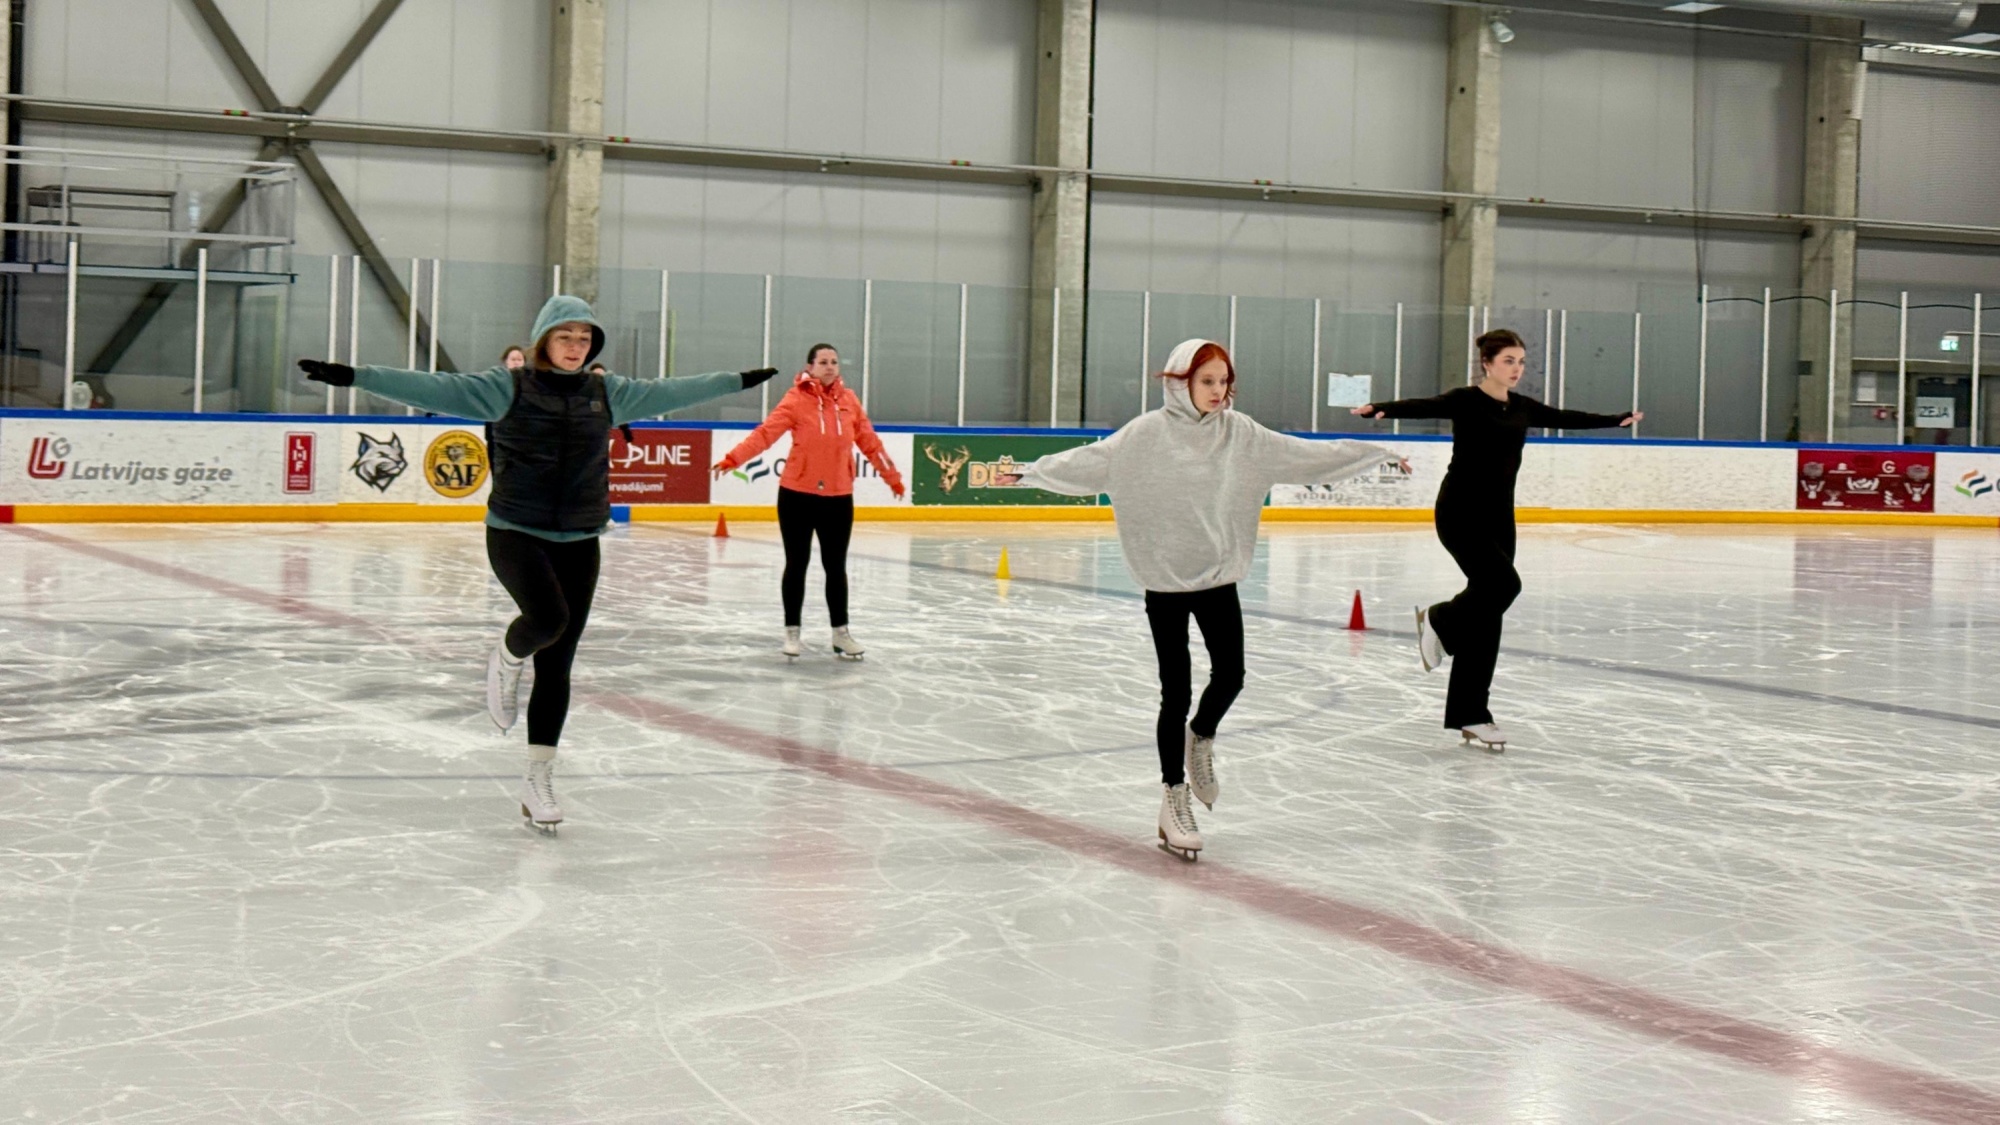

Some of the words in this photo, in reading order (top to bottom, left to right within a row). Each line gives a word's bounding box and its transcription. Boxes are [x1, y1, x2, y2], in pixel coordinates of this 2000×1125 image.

[71, 461, 169, 485] Latvijas
[173, 462, 233, 486] gāze
[435, 463, 481, 486] SAF
